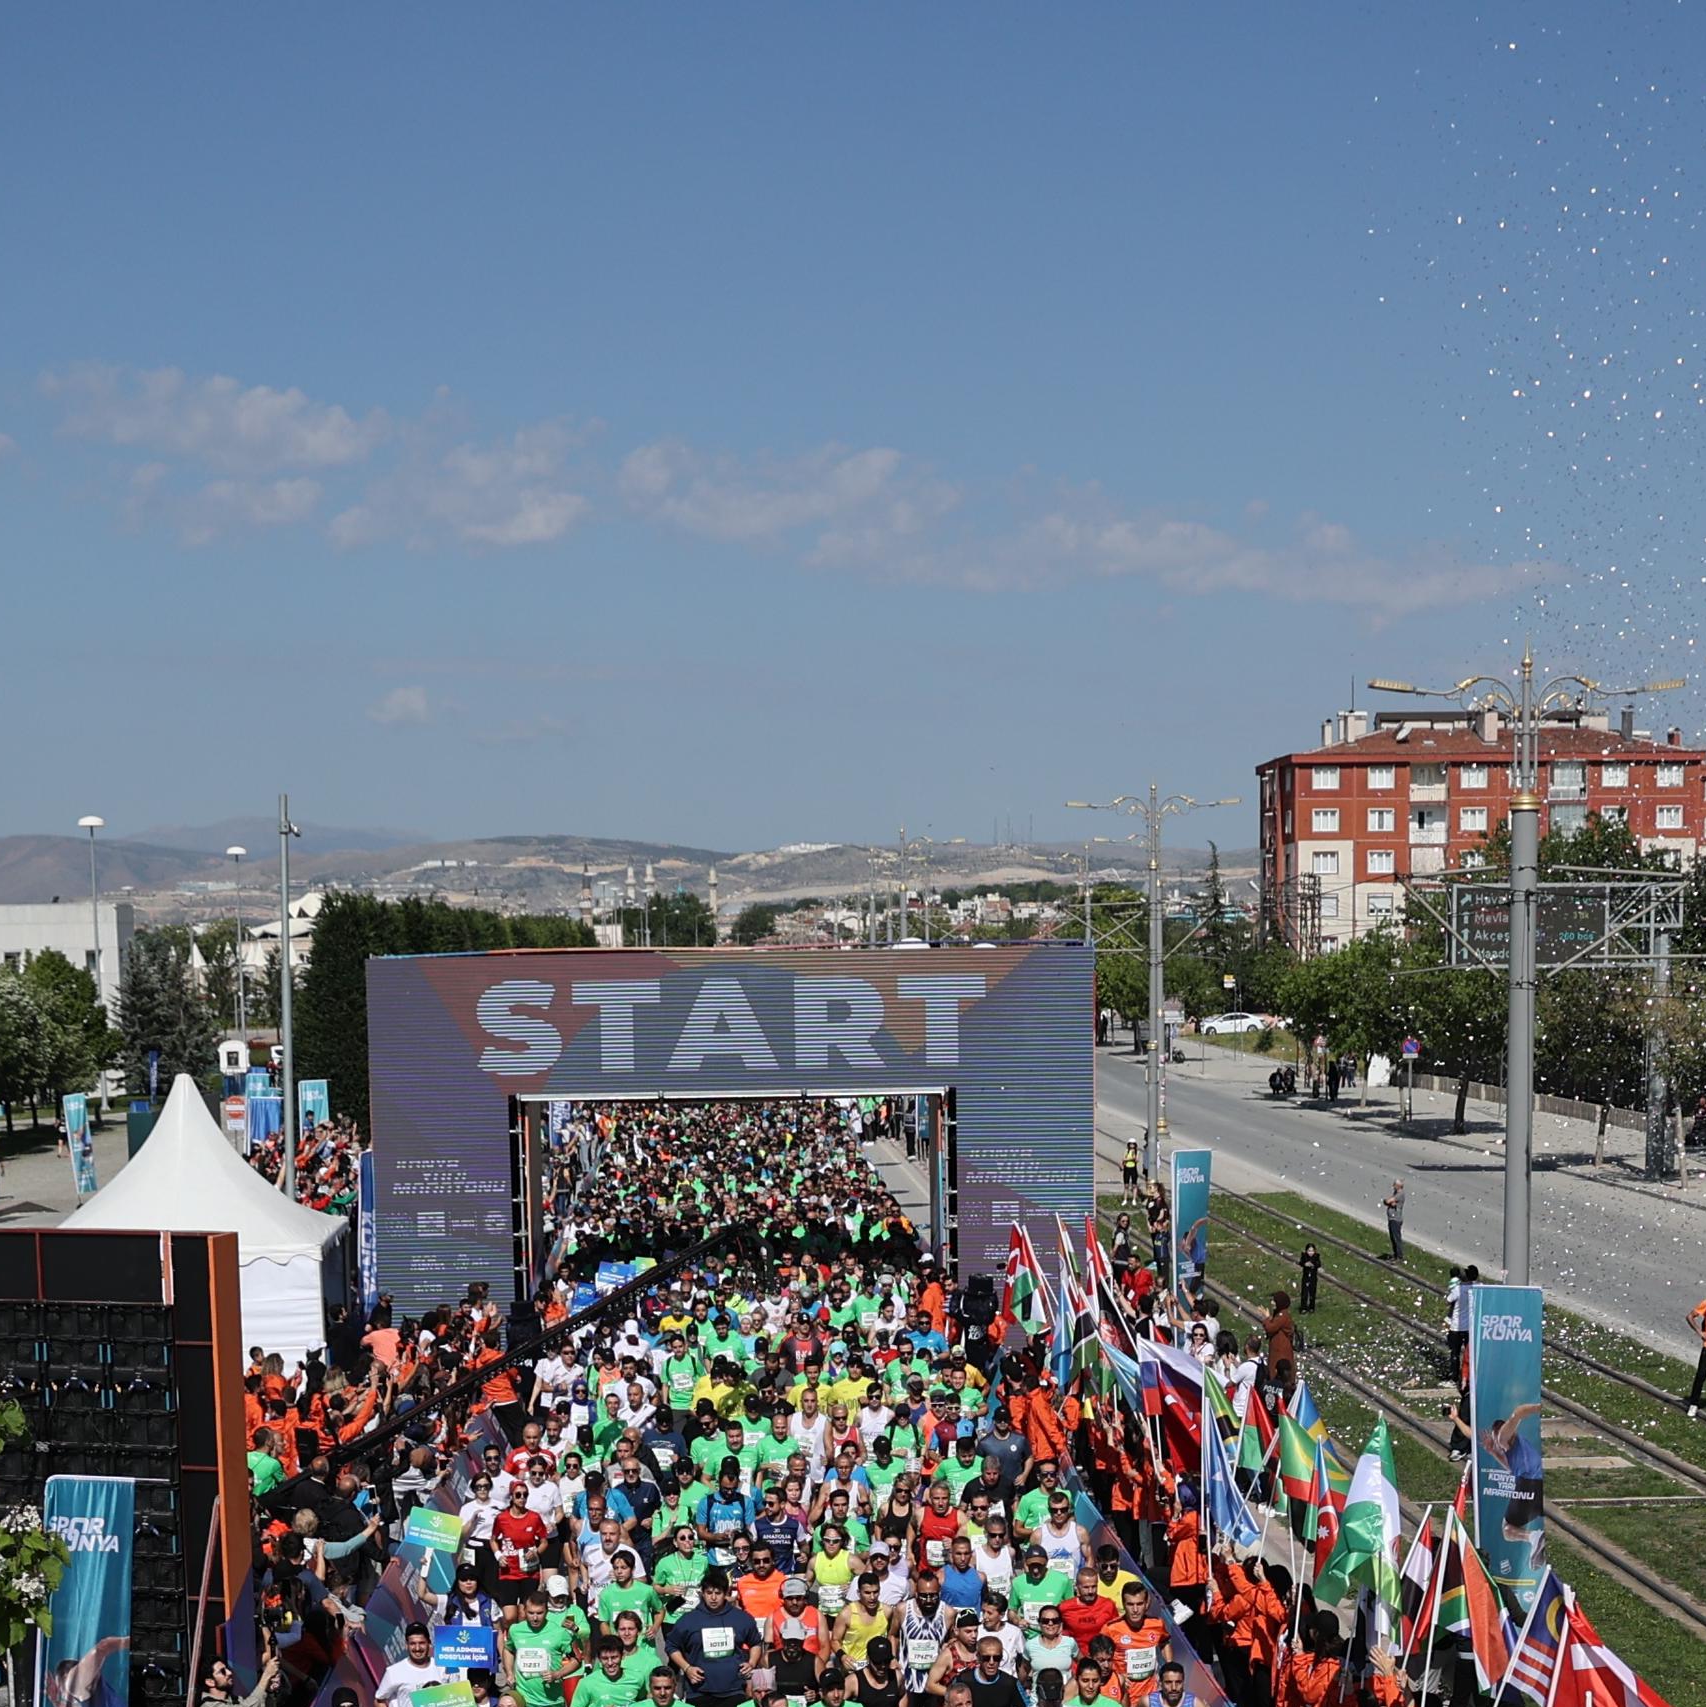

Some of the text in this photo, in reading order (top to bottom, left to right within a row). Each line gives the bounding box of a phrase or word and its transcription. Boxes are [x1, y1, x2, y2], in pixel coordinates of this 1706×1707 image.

[477, 973, 986, 1076] START
[1481, 1315, 1522, 1332] SPOR
[1482, 1325, 1533, 1342] KONYA
[1488, 1472, 1516, 1482] KONYA
[1498, 1481, 1516, 1490] YARI
[1483, 1487, 1535, 1500] MARATONU
[48, 1516, 105, 1536] SPOR
